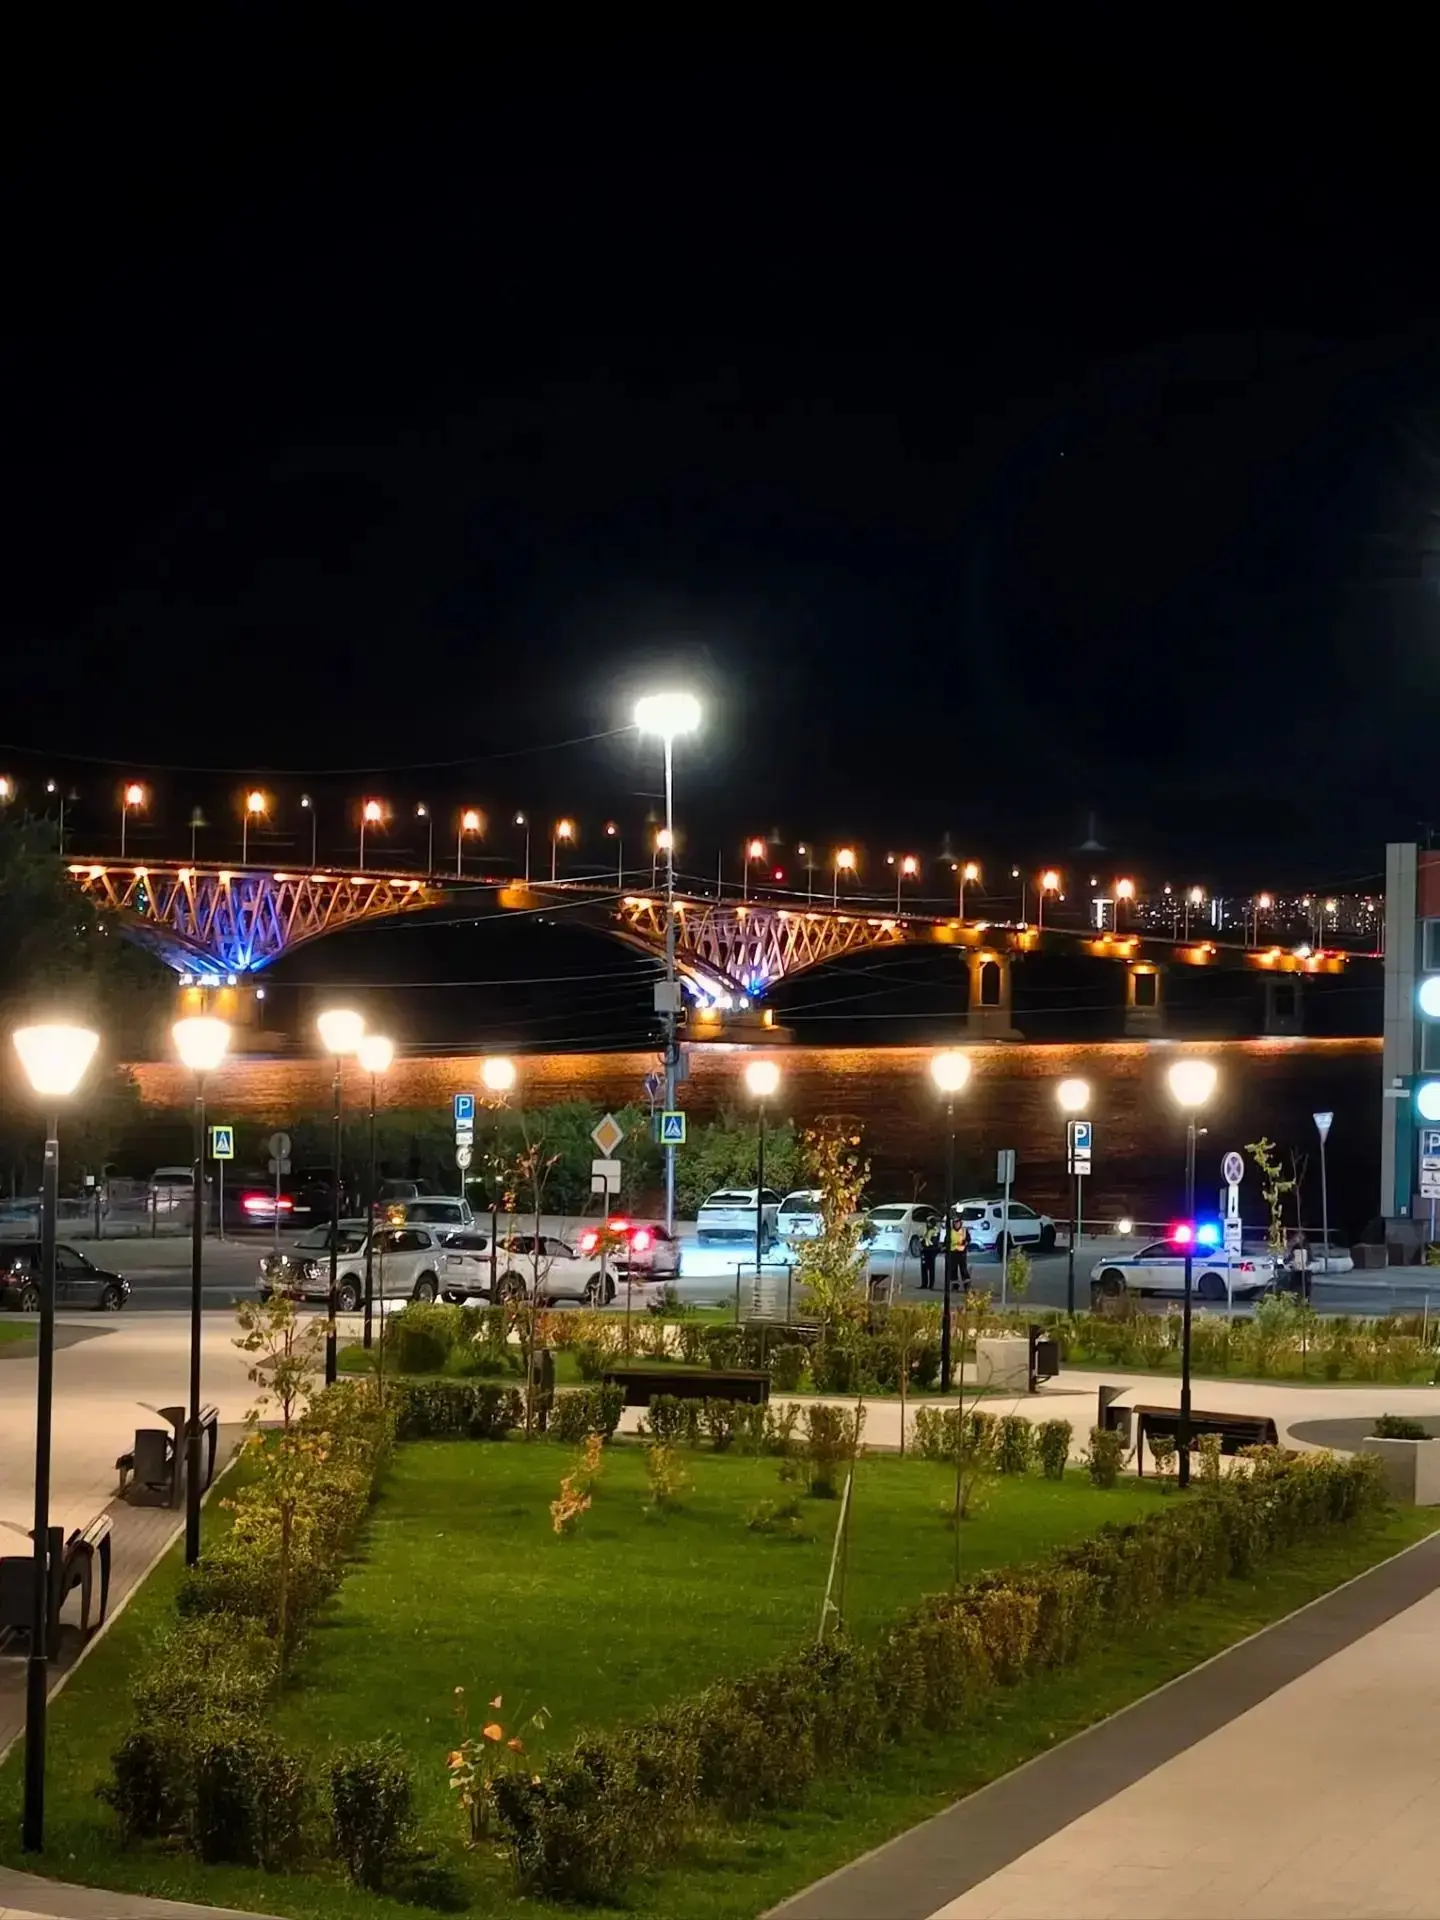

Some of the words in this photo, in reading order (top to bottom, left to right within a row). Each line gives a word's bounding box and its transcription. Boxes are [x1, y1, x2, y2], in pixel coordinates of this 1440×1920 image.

[459, 1097, 471, 1117] P
[1074, 1124, 1087, 1147] P
[1429, 1132, 1440, 1154] P
